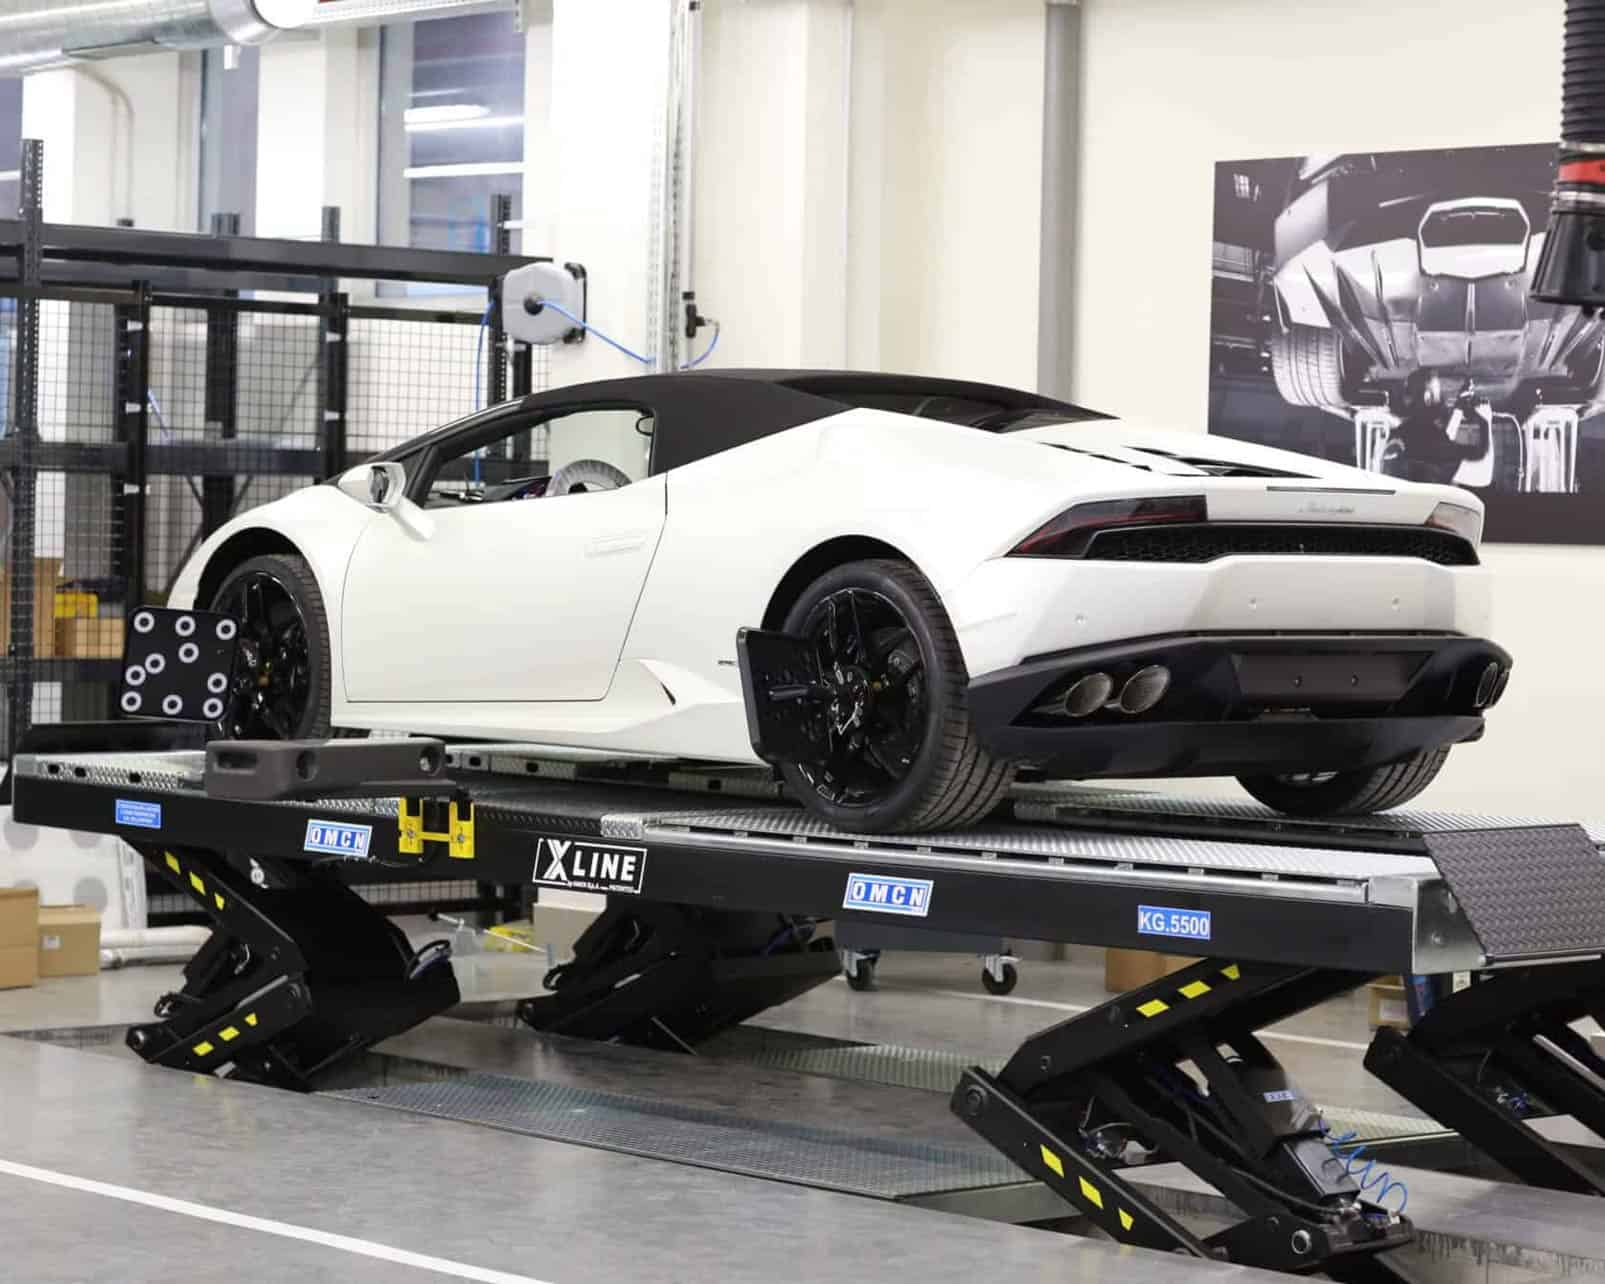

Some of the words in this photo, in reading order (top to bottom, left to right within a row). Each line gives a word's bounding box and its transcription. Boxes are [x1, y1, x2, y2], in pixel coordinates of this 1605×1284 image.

[311, 827, 368, 850] OMCN
[852, 881, 924, 907] OMCN
[1140, 911, 1209, 936] KG.5500
